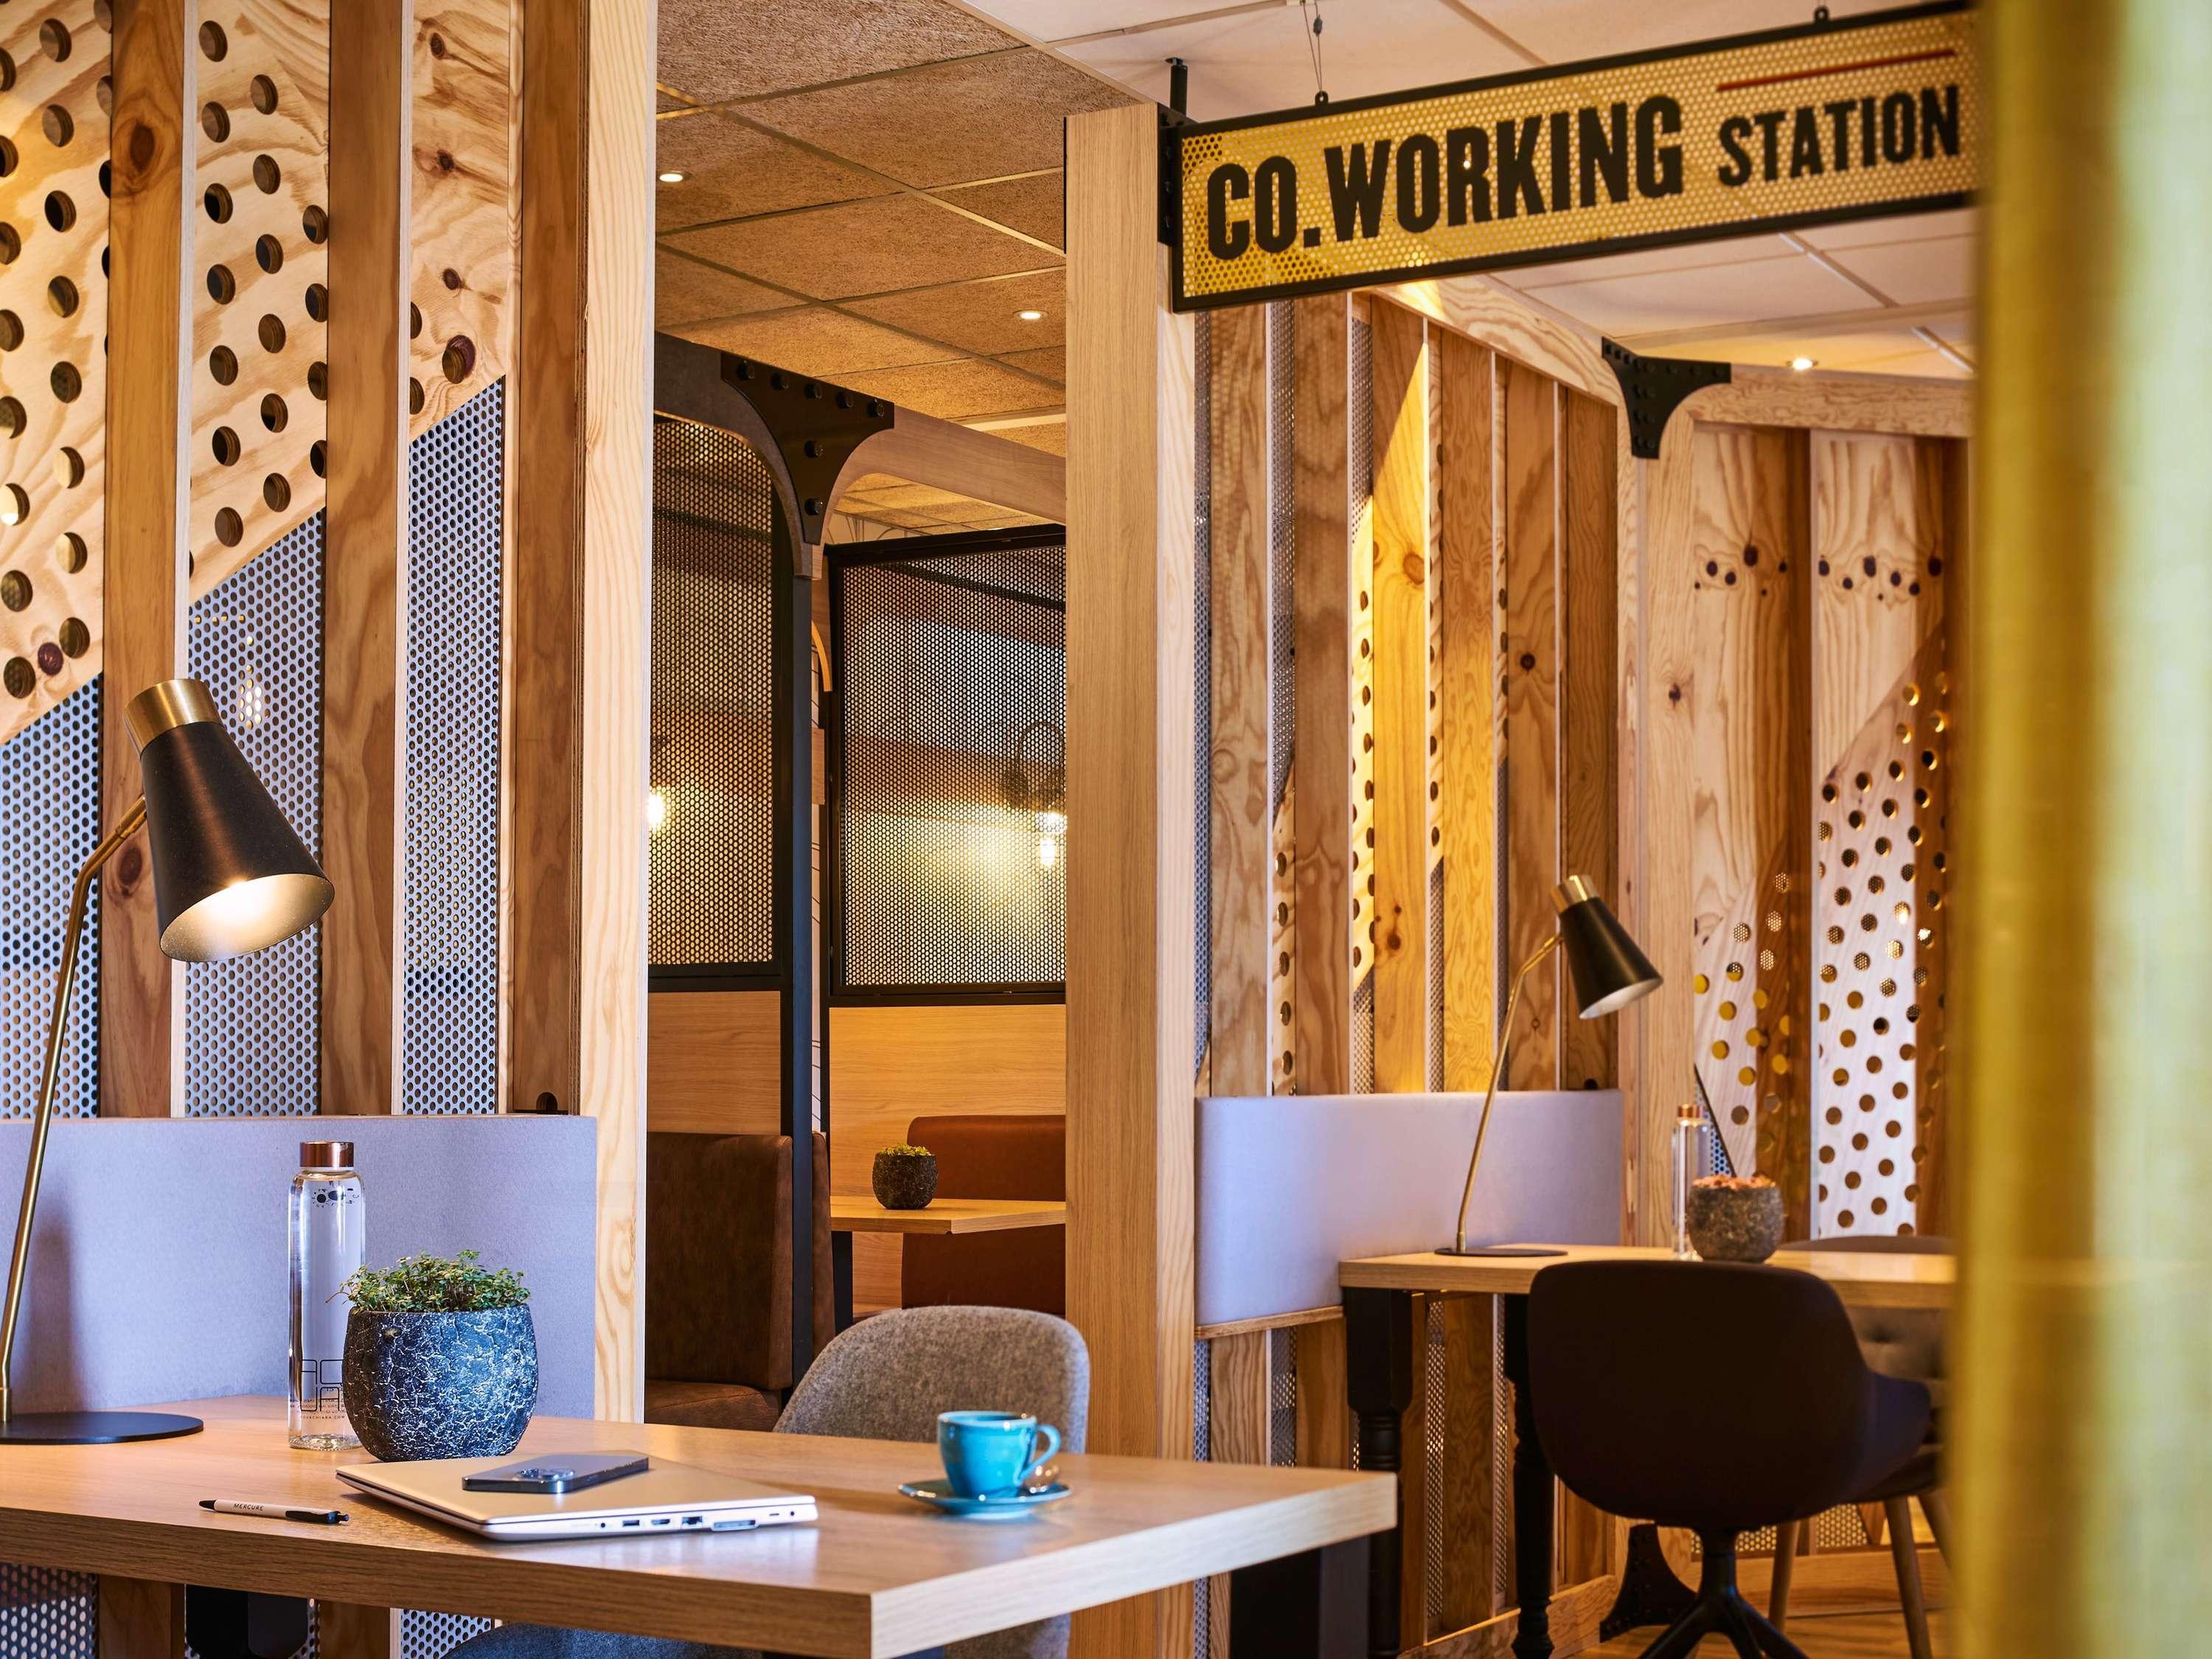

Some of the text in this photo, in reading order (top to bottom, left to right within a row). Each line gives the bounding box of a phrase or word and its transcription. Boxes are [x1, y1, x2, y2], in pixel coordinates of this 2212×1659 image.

[1206, 84, 1960, 260] CO.WORKING STATION
[233, 1503, 264, 1511] MERCURE
